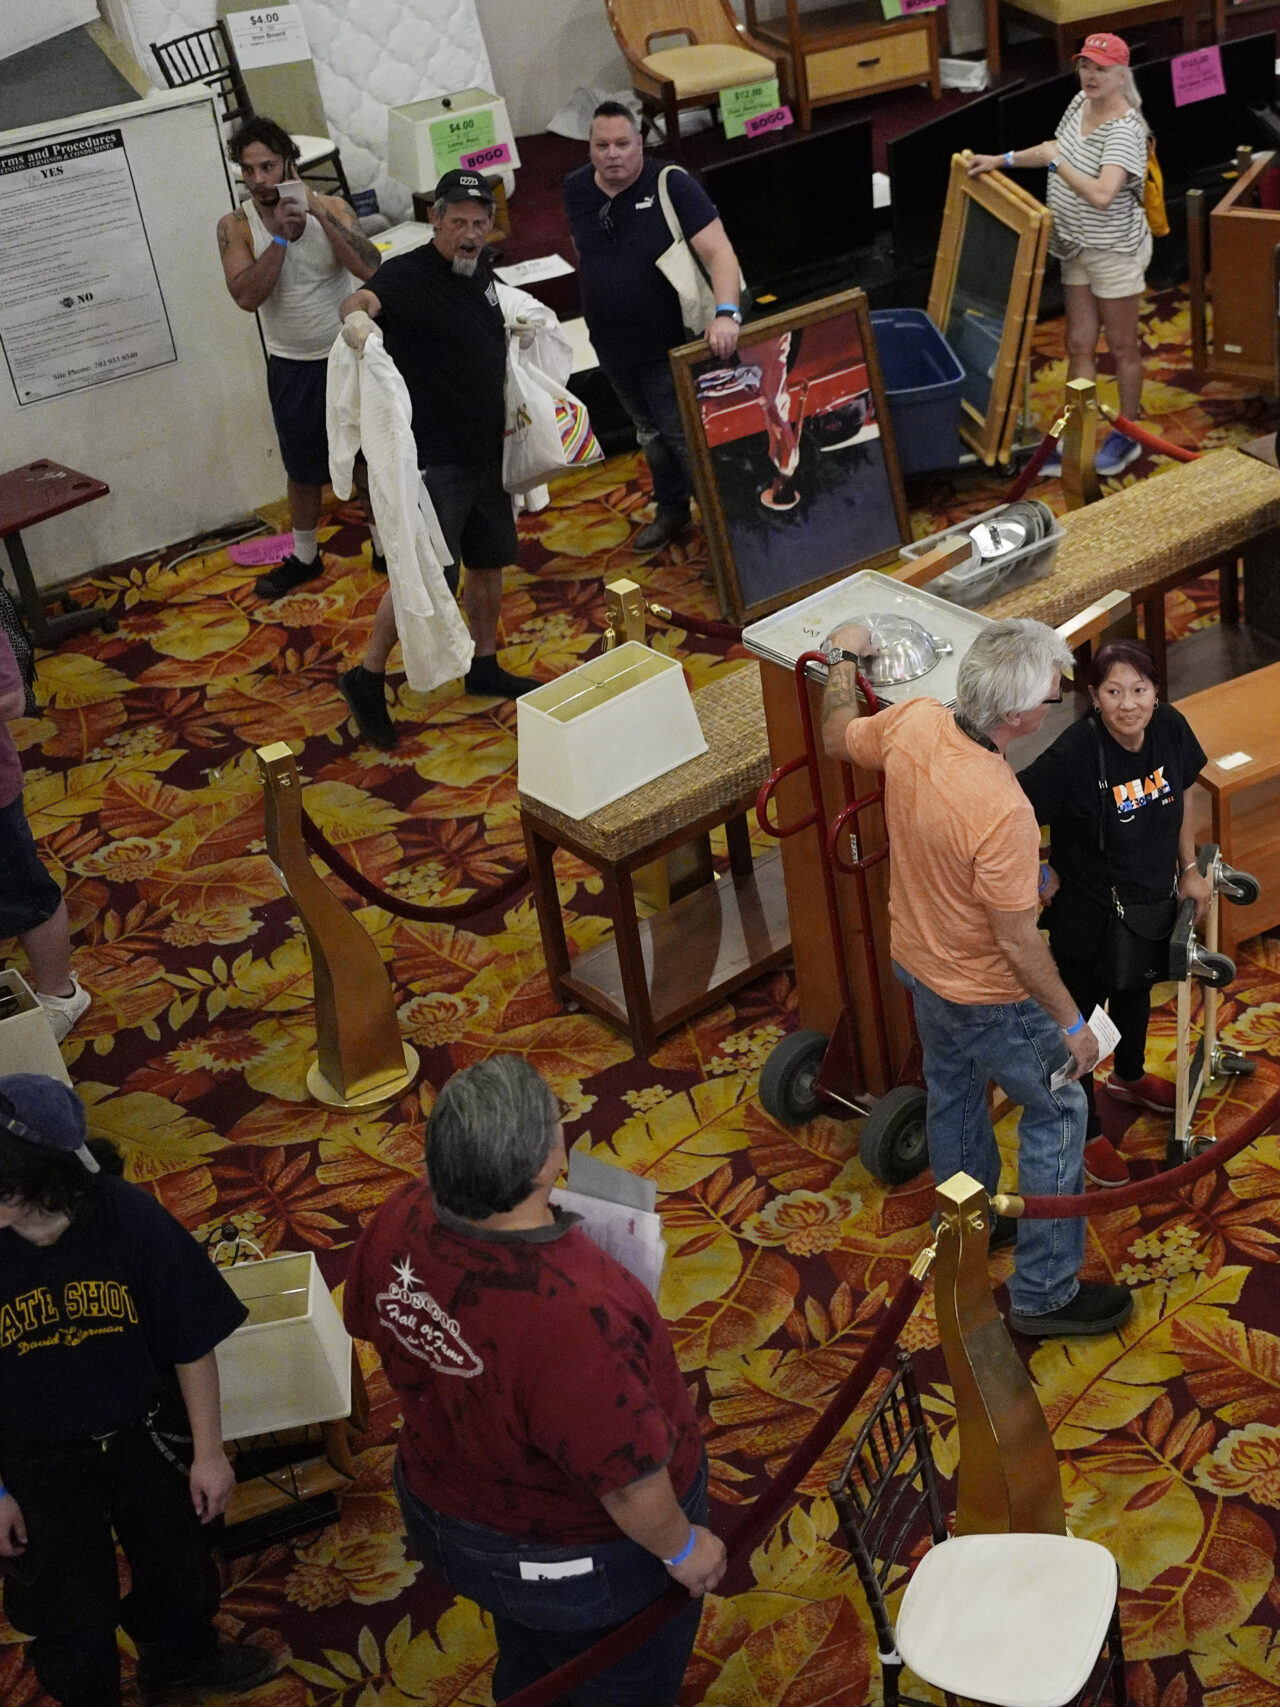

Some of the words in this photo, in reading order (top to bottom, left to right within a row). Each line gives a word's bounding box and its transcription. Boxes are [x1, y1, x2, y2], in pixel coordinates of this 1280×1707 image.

[250, 13, 279, 26] $4.00
[449, 120, 475, 133] $4.00
[751, 111, 785, 131] BOGO
[0, 155, 25, 168] rms
[27, 147, 49, 162] and
[52, 133, 118, 156] Procedures
[467, 148, 503, 168] BOGO
[41, 166, 64, 179] YES
[77, 292, 94, 304] NO
[0, 1286, 60, 1347] ATE
[18, 1332, 60, 1357] David
[59, 1326, 124, 1346] Leerman
[386, 1303, 418, 1330] Hall
[420, 1324, 434, 1341] of
[433, 1331, 465, 1366] Fame
